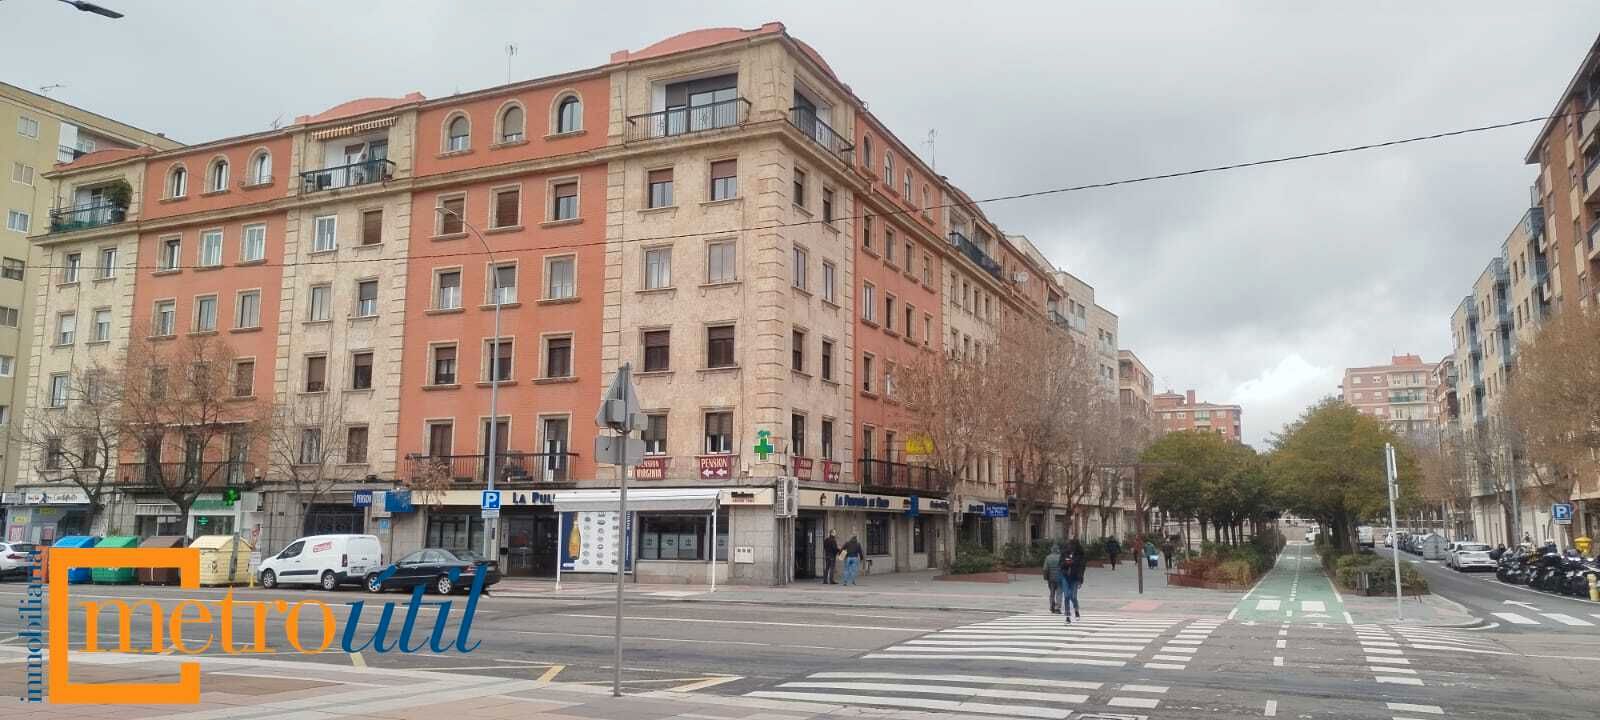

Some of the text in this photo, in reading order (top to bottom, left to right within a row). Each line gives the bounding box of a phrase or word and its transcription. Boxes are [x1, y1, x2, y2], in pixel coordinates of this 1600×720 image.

[701, 457, 728, 469] PENSION
[486, 492, 497, 507] P
[1556, 506, 1567, 518] P
